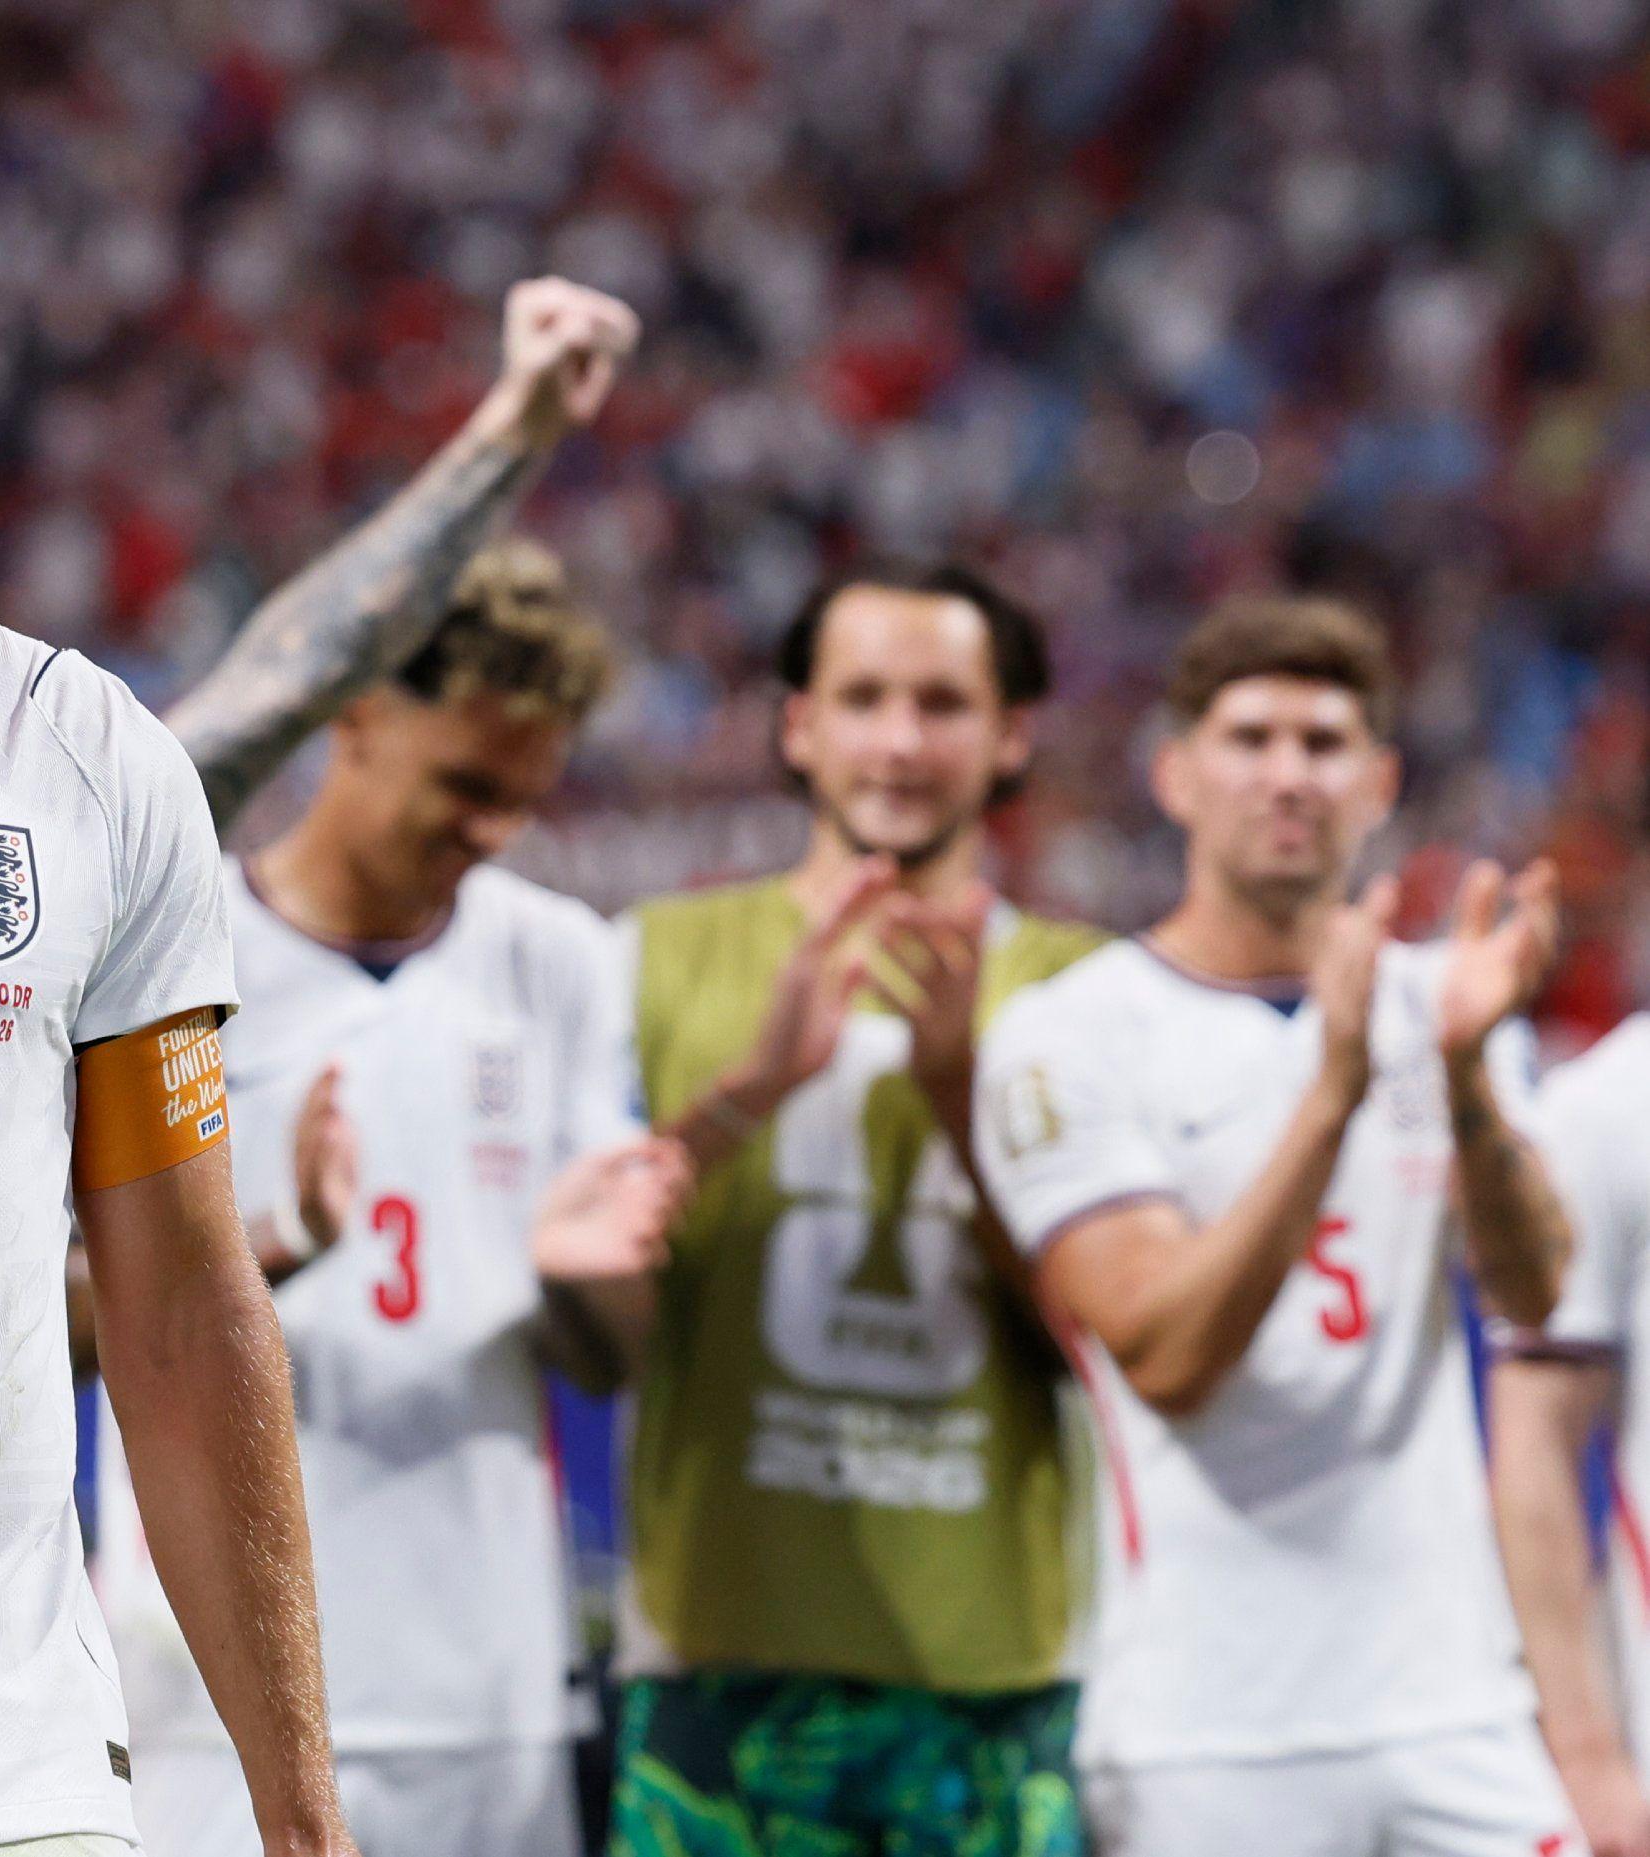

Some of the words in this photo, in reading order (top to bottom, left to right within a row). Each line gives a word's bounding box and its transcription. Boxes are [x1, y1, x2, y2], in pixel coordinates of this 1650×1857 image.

[12, 984, 33, 1010] DR
[158, 1006, 218, 1058] FOOTBAL
[161, 1092, 198, 1129] the
[197, 1065, 226, 1110] Worl
[200, 1113, 223, 1137] FIFA
[371, 1195, 418, 1323] 3
[1306, 1217, 1365, 1341] 5
